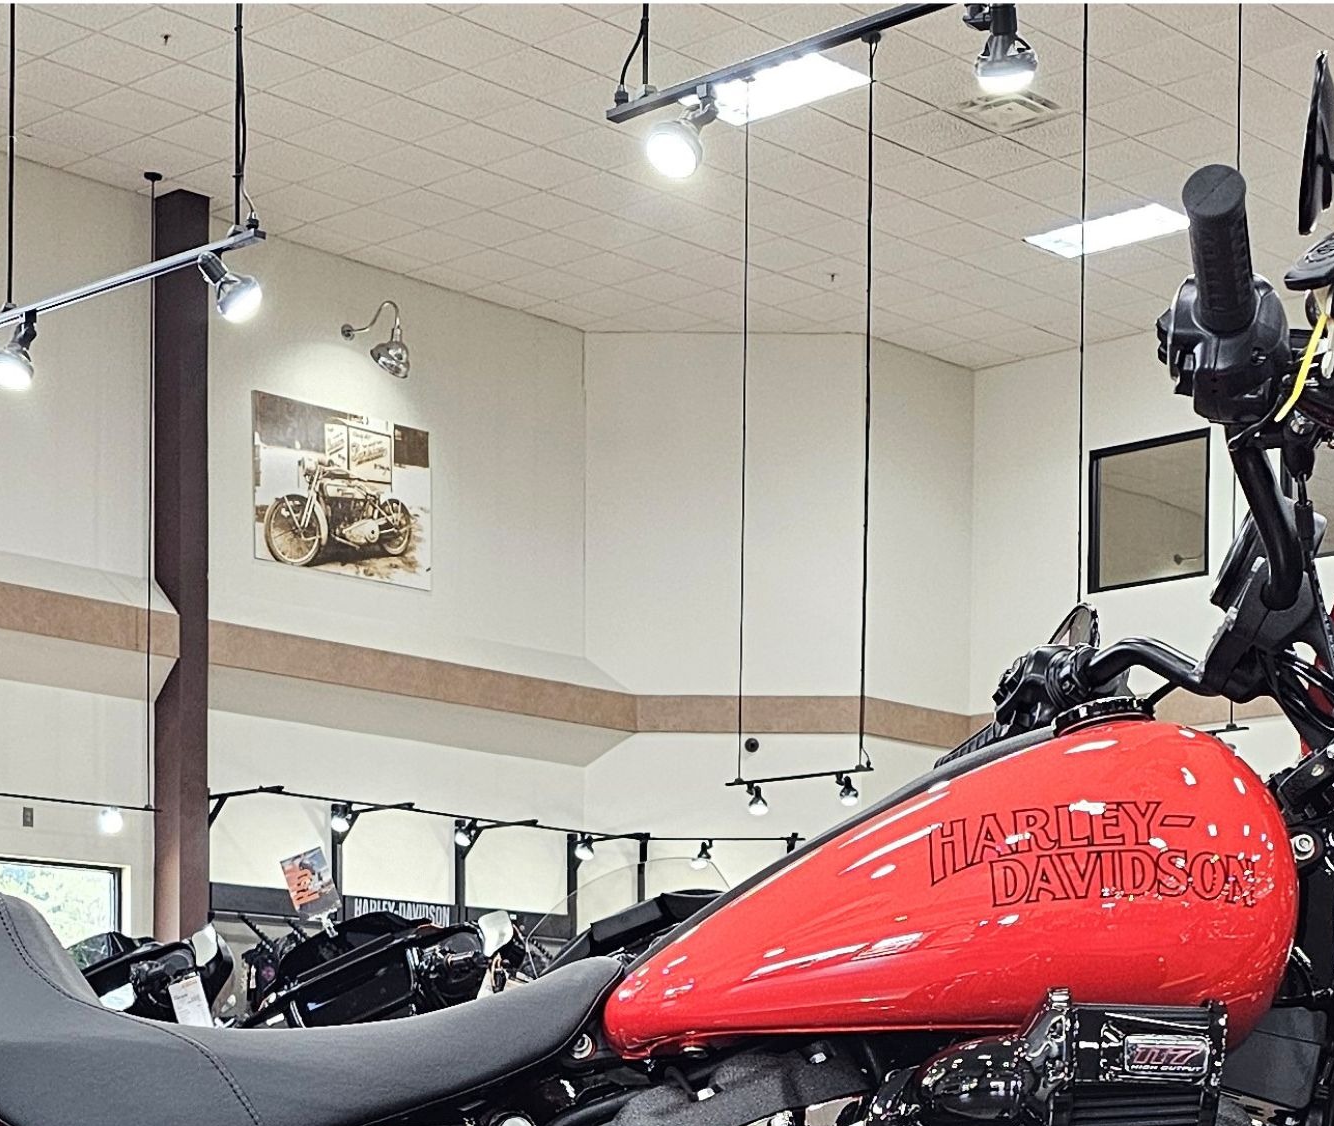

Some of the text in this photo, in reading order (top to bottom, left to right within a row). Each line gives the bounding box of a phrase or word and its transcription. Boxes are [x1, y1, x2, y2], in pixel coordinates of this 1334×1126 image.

[989, 849, 1258, 908] DAVIDSON
[1132, 1043, 1201, 1064] 117
[1160, 1064, 1203, 1072] OUTPUT
